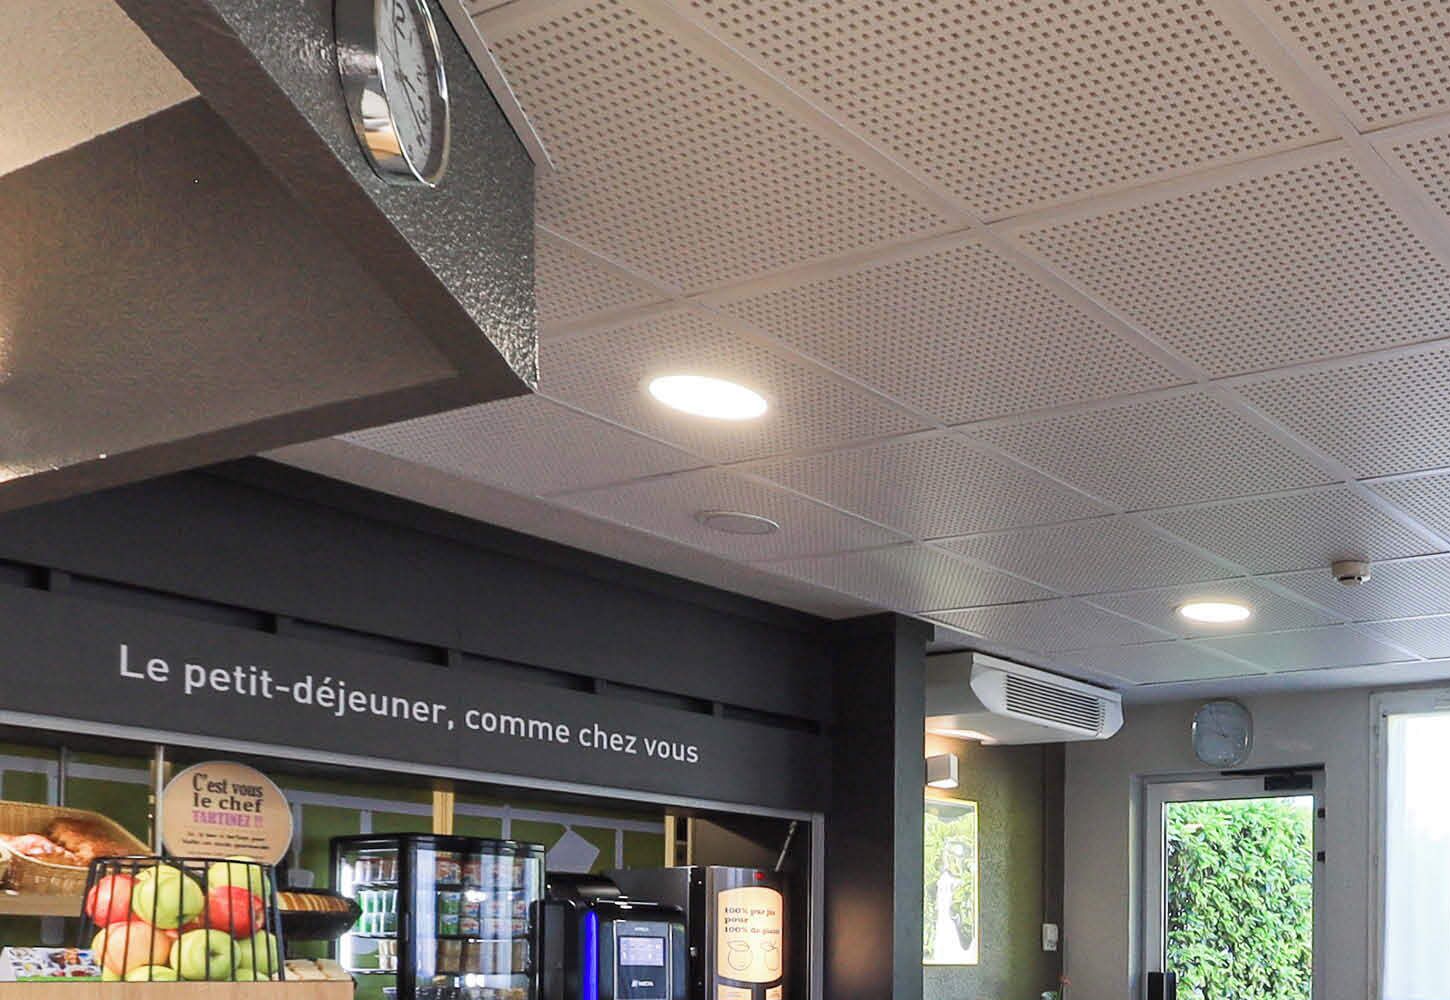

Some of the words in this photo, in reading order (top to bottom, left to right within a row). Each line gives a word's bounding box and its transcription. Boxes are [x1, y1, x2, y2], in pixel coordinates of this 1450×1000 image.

[119, 644, 170, 682] Le
[184, 662, 454, 731] petit-déjeuner,
[465, 709, 570, 744] comme
[578, 723, 637, 755] chez
[643, 737, 699, 763] vous
[192, 773, 227, 795] C'est
[232, 783, 263, 798] vous
[193, 792, 212, 808] le
[219, 795, 264, 813] chef
